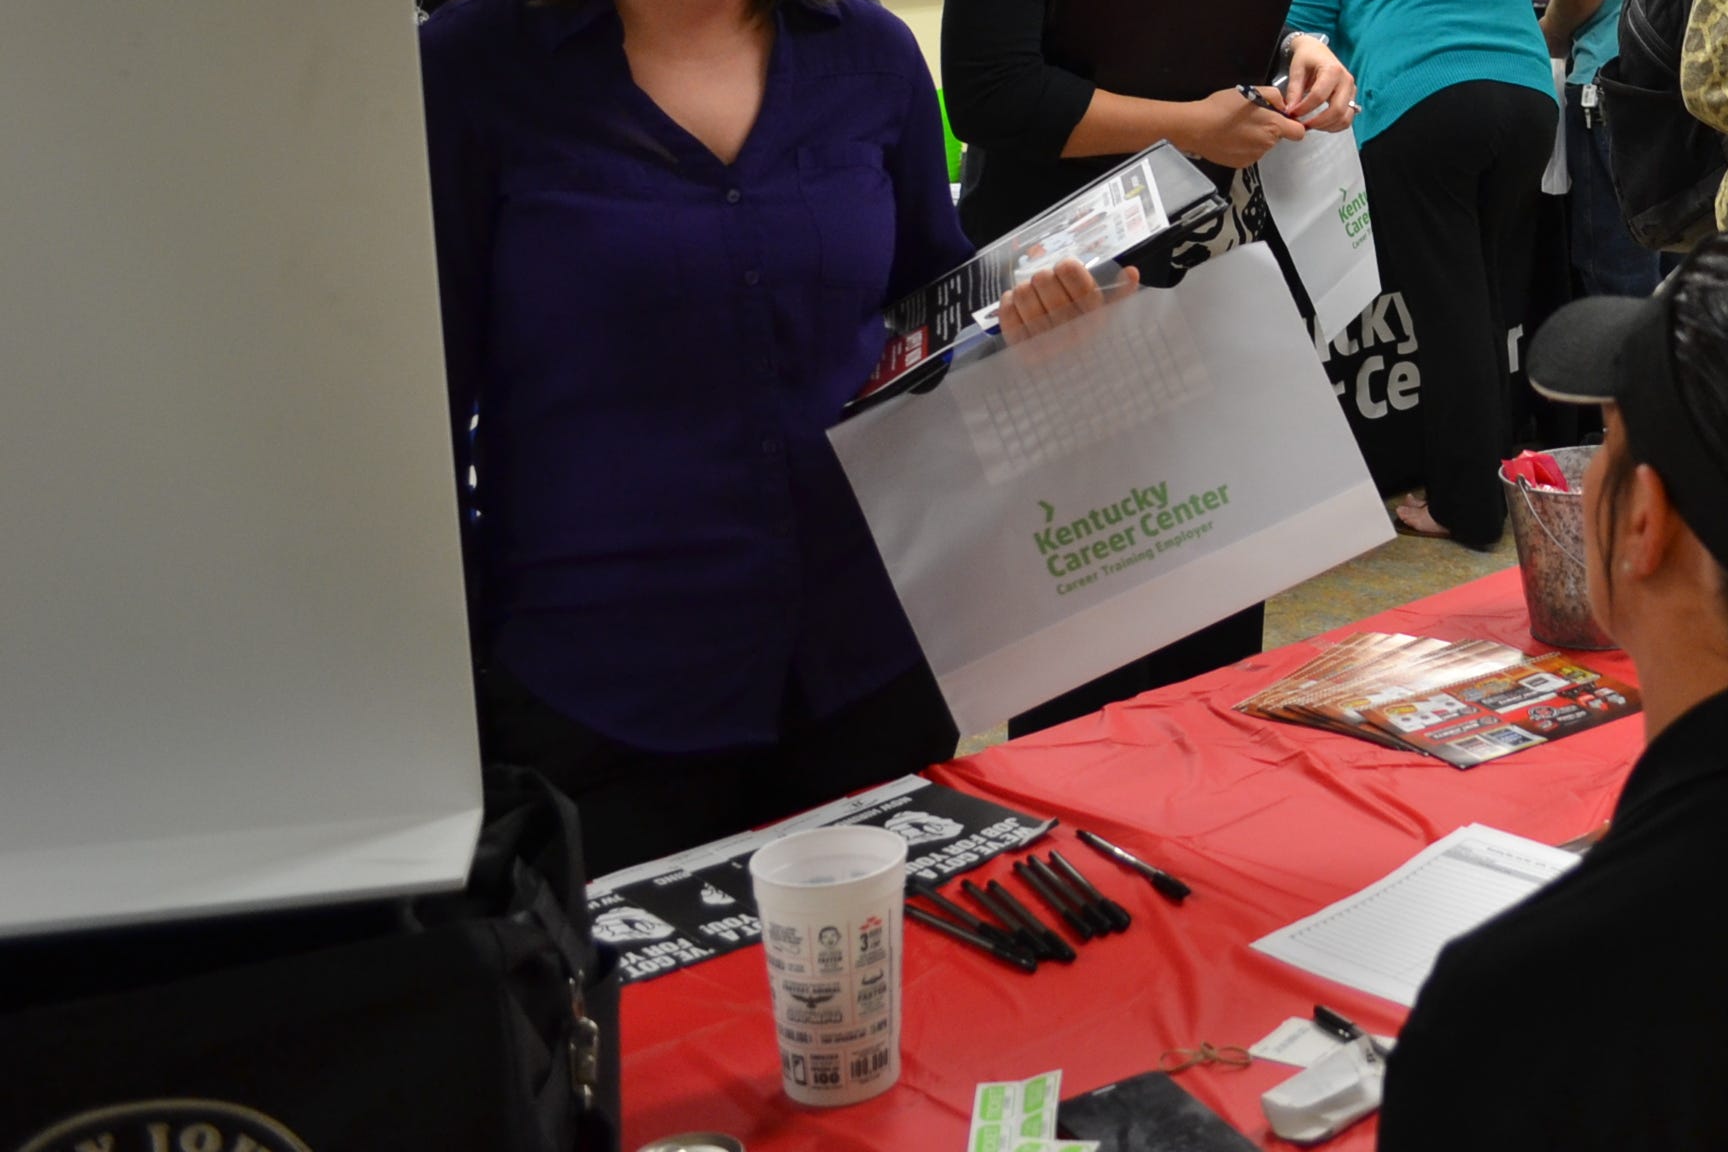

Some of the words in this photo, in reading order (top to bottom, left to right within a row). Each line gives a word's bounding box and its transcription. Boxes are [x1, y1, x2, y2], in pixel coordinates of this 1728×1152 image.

[1345, 212, 1370, 238] Care
[1033, 480, 1169, 556] Kentucky
[1046, 526, 1136, 578] Career
[1139, 483, 1230, 538] Center
[1056, 571, 1098, 596] Career
[1101, 548, 1156, 577] Training
[1154, 520, 1214, 554] Employer
[980, 817, 1020, 840] JOB
[941, 834, 986, 856] FOR
[974, 826, 1032, 856] WE'VE
[916, 868, 938, 880] A
[935, 852, 980, 873] GOT
[640, 938, 692, 959] FOR
[860, 933, 868, 952] 3
[624, 955, 676, 979] GOT
[814, 1072, 840, 1085] 100
